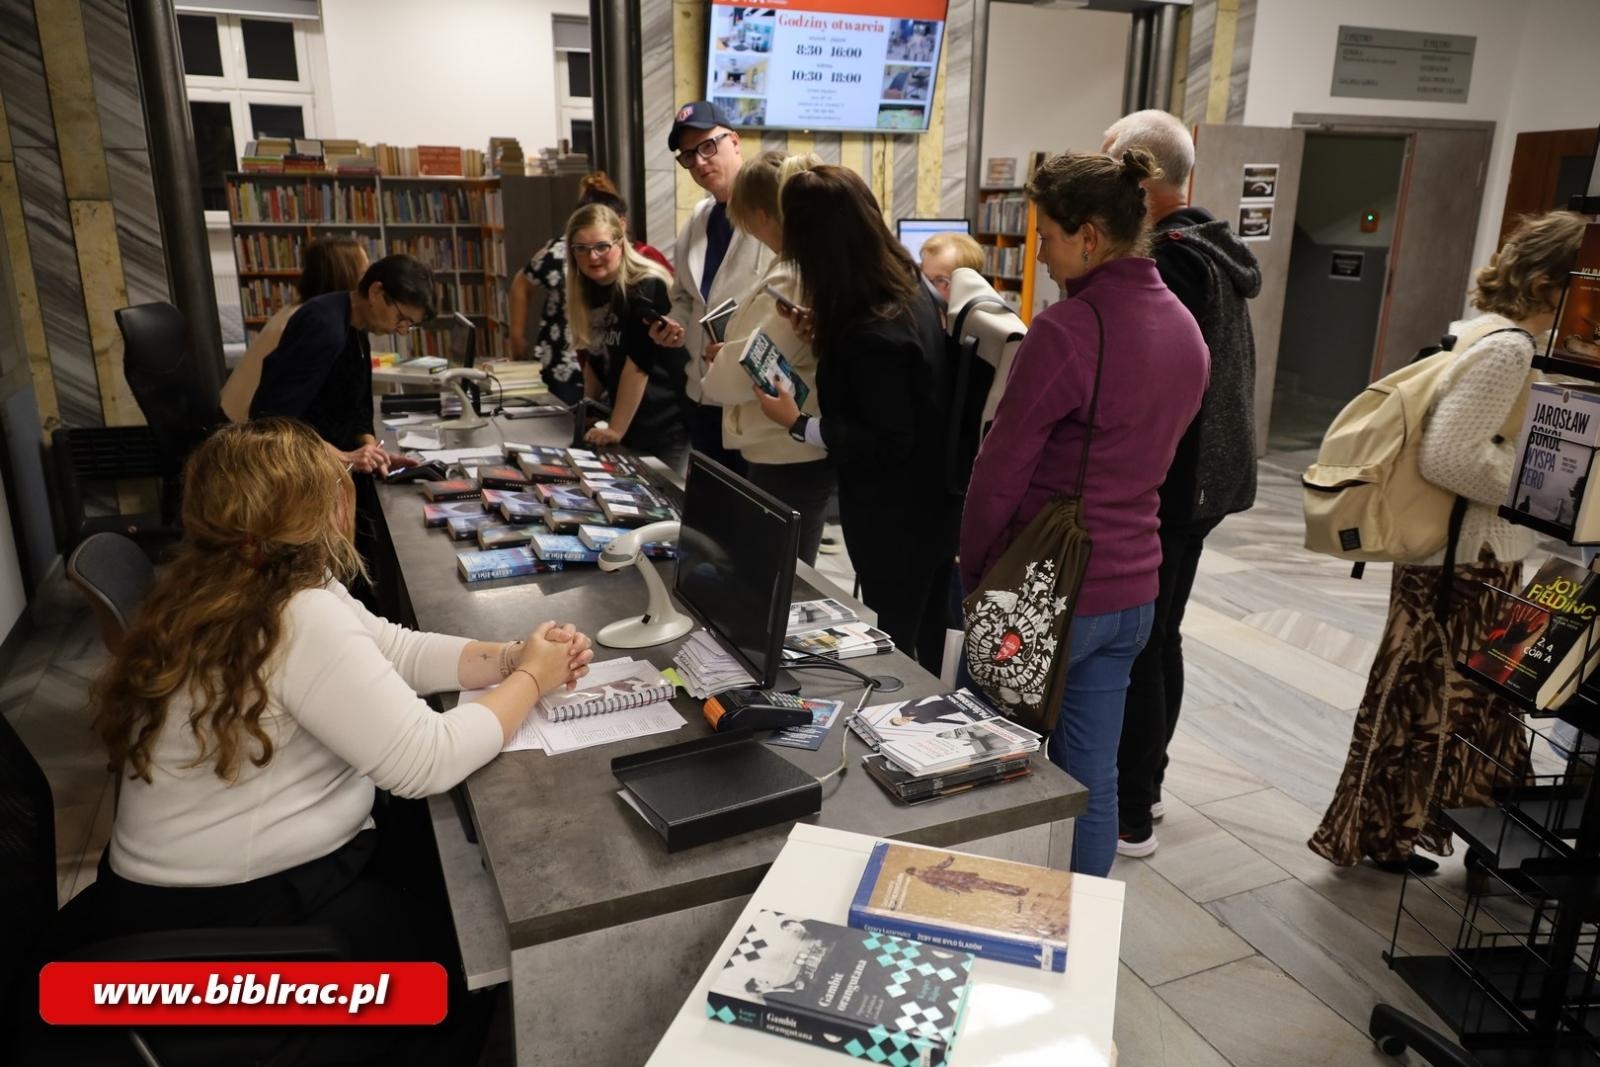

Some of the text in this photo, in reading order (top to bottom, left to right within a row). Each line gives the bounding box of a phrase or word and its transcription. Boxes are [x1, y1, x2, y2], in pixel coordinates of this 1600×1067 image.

[778, 13, 885, 33] Godziny otwarcia
[796, 43, 862, 58] 8:30 16:00
[791, 69, 862, 84] 10:30 18:00
[1533, 403, 1591, 435] JAROSŁAW
[1546, 575, 1583, 598] JOY
[1527, 583, 1597, 621] FIELDING
[818, 972, 845, 1007] Gambit
[837, 959, 867, 1011] orangutana
[766, 1012, 797, 1028] Gambit
[766, 1024, 813, 1041] orangutana
